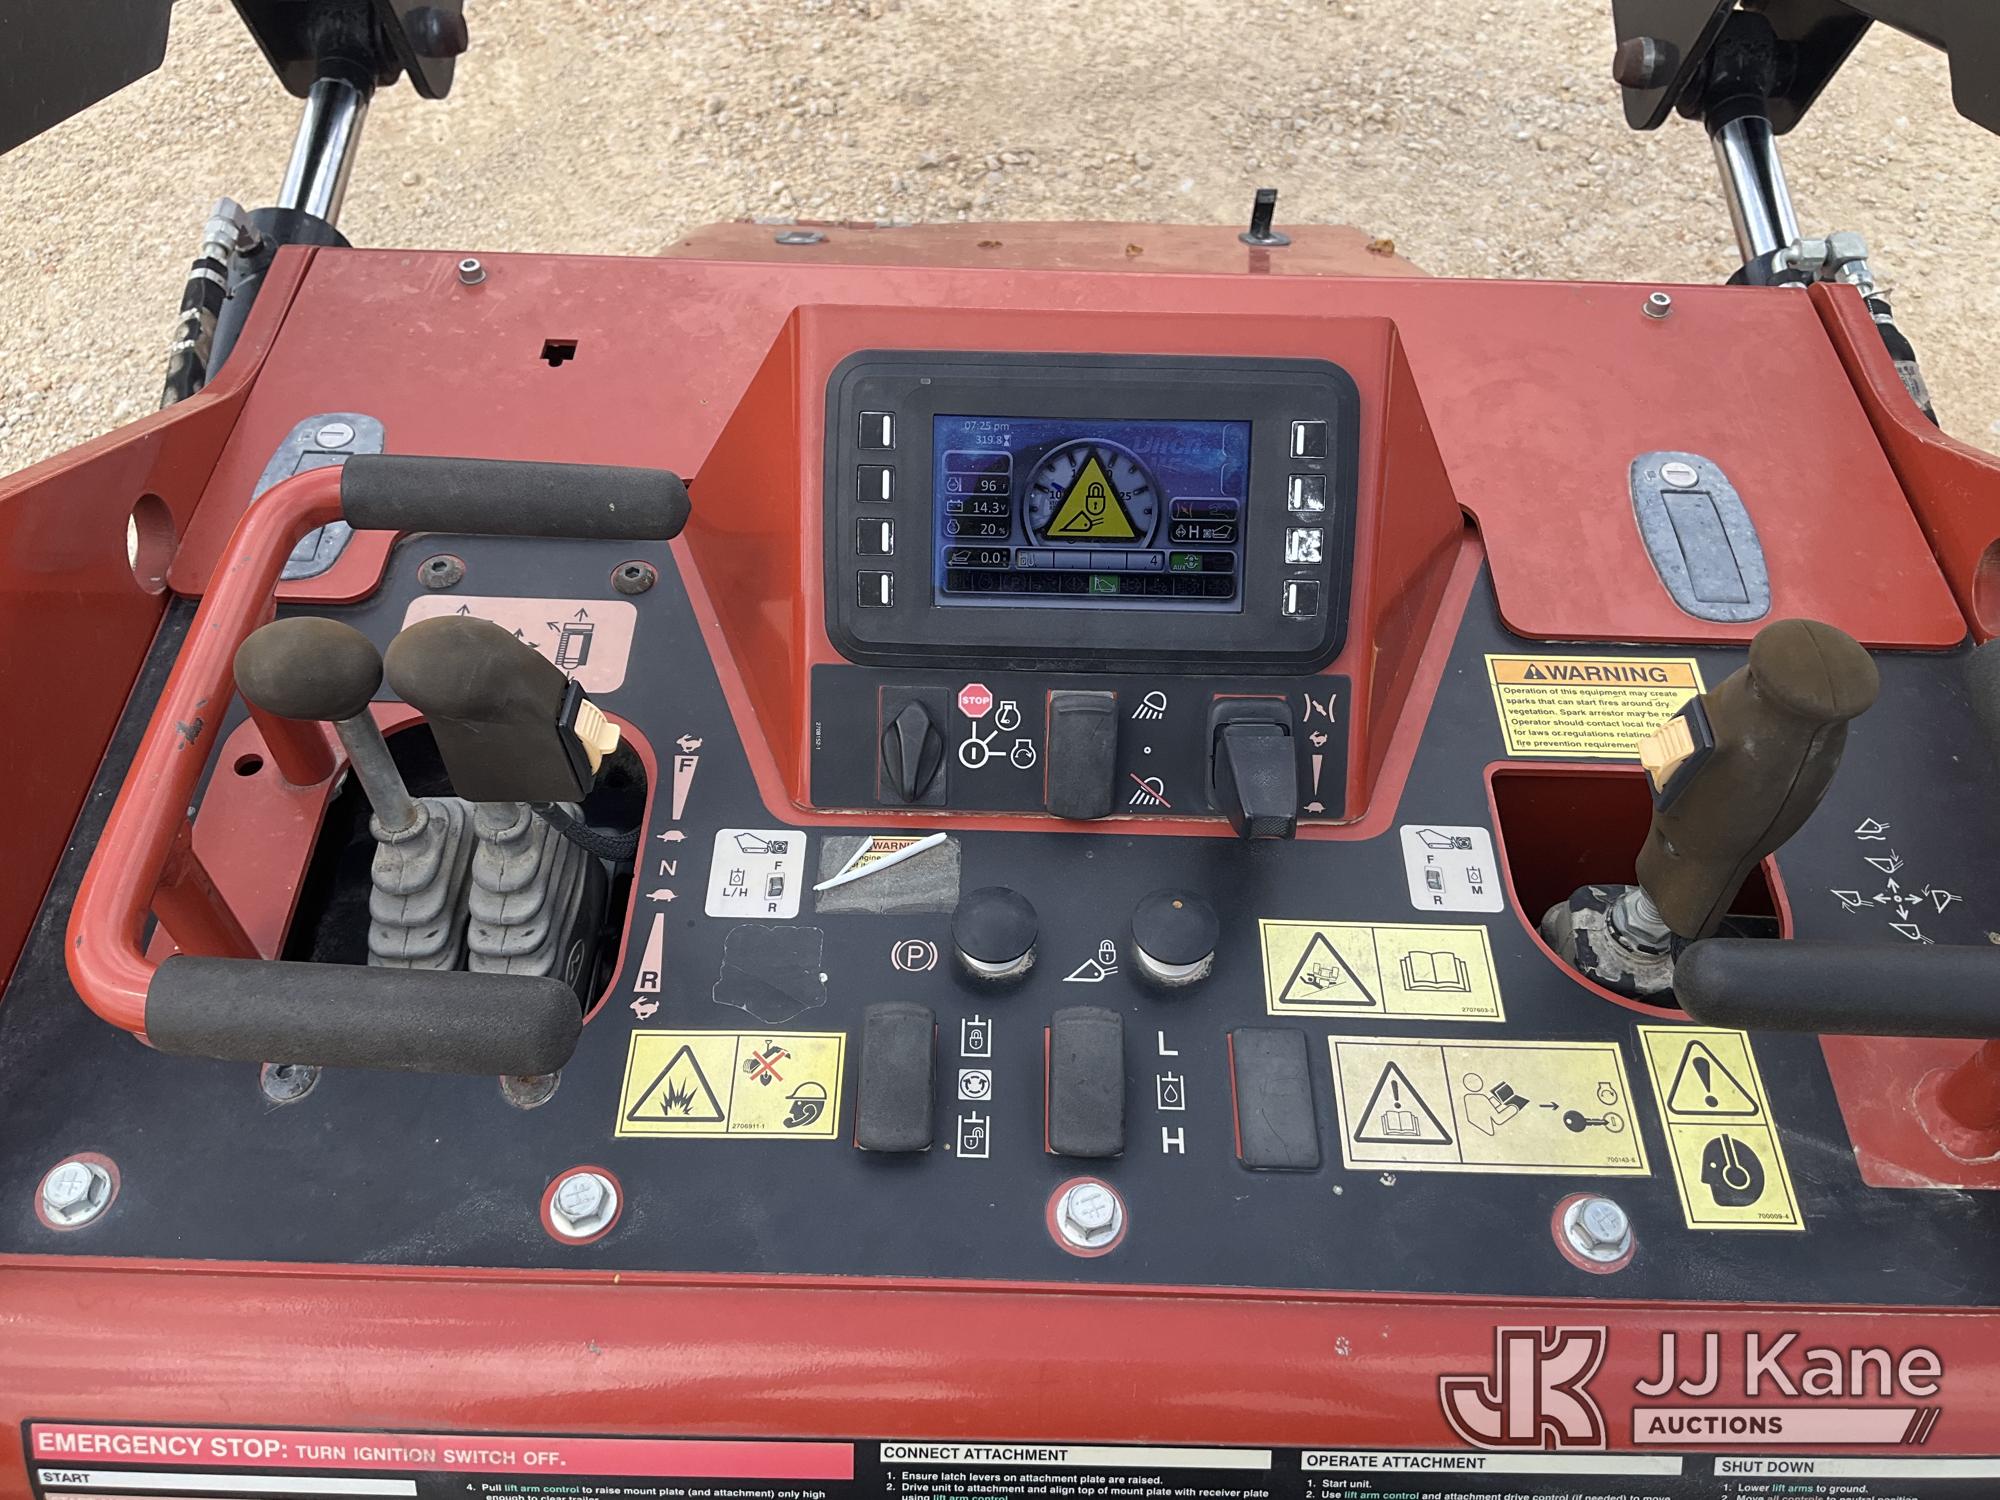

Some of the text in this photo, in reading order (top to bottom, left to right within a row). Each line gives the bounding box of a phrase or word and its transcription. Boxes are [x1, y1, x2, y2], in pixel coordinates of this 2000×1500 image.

[964, 421, 1009, 432] 07:25 pm
[976, 435, 1002, 444] 319.8
[981, 480, 997, 491] 96
[1049, 491, 1062, 499] 10
[1120, 492, 1132, 500] 25
[973, 502, 1000, 513] 14.3
[980, 523, 996, 535] 20
[1189, 525, 1199, 538] H
[981, 551, 1000, 563] 0.0
[1150, 555, 1158, 566] 4
[1545, 665, 1668, 683] WARNING
[1504, 687, 1547, 695] Operation
[1580, 689, 1627, 697] equipment
[962, 696, 990, 706] STOP
[1511, 718, 1551, 726] Operator
[1563, 730, 1614, 738] regulations
[678, 758, 694, 773] F
[1426, 855, 1435, 864] F
[659, 861, 678, 877] N
[774, 861, 783, 871] F
[723, 888, 748, 898] L/H
[1472, 886, 1483, 895] M
[1434, 895, 1442, 905] R
[768, 903, 777, 913] R
[907, 945, 924, 967] P
[639, 972, 659, 989] R
[1158, 1031, 1179, 1056] L
[1162, 1127, 1186, 1154] H
[38, 1432, 567, 1466] EMERGENCY STOP: TURN IGNITION SWITCH OFF.
[884, 1446, 1068, 1461] CONNECT ATTACHMENT
[1307, 1455, 1486, 1469] OPERATE ATTACHMENT
[1722, 1461, 1815, 1473] SHUT DOWN
[43, 1472, 90, 1484] START
[886, 1472, 1163, 1485] 1. Ensure latch levers on attachment plate are raised.
[1307, 1479, 1372, 1488] 1. Start unit.
[466, 1483, 476, 1491] 4.
[482, 1483, 502, 1492] Pull
[504, 1484, 518, 1492] lift
[543, 1485, 580, 1493] control
[582, 1486, 593, 1494] to
[595, 1486, 621, 1494] raise
[624, 1487, 657, 1496] mount
[659, 1487, 685, 1497] plate
[688, 1488, 711, 1497] (and
[713, 1488, 775, 1499] attachment)
[778, 1490, 800, 1500] only
[802, 1490, 826, 1500] high
[886, 1482, 1269, 1499] 2. Drive unit to attachment and align top of mount plate with receiver plate
[1723, 1484, 1732, 1492] 1.
[1738, 1484, 1770, 1492] Lower
[1772, 1483, 1785, 1492] lift
[1788, 1485, 1813, 1493] arms
[1829, 1485, 1868, 1495] ground.
[1306, 1491, 1315, 1499] 2.
[1321, 1491, 1342, 1499] Use
[1344, 1491, 1357, 1499] lift
[1382, 1491, 1419, 1500] control
[1422, 1492, 1442, 1500] and
